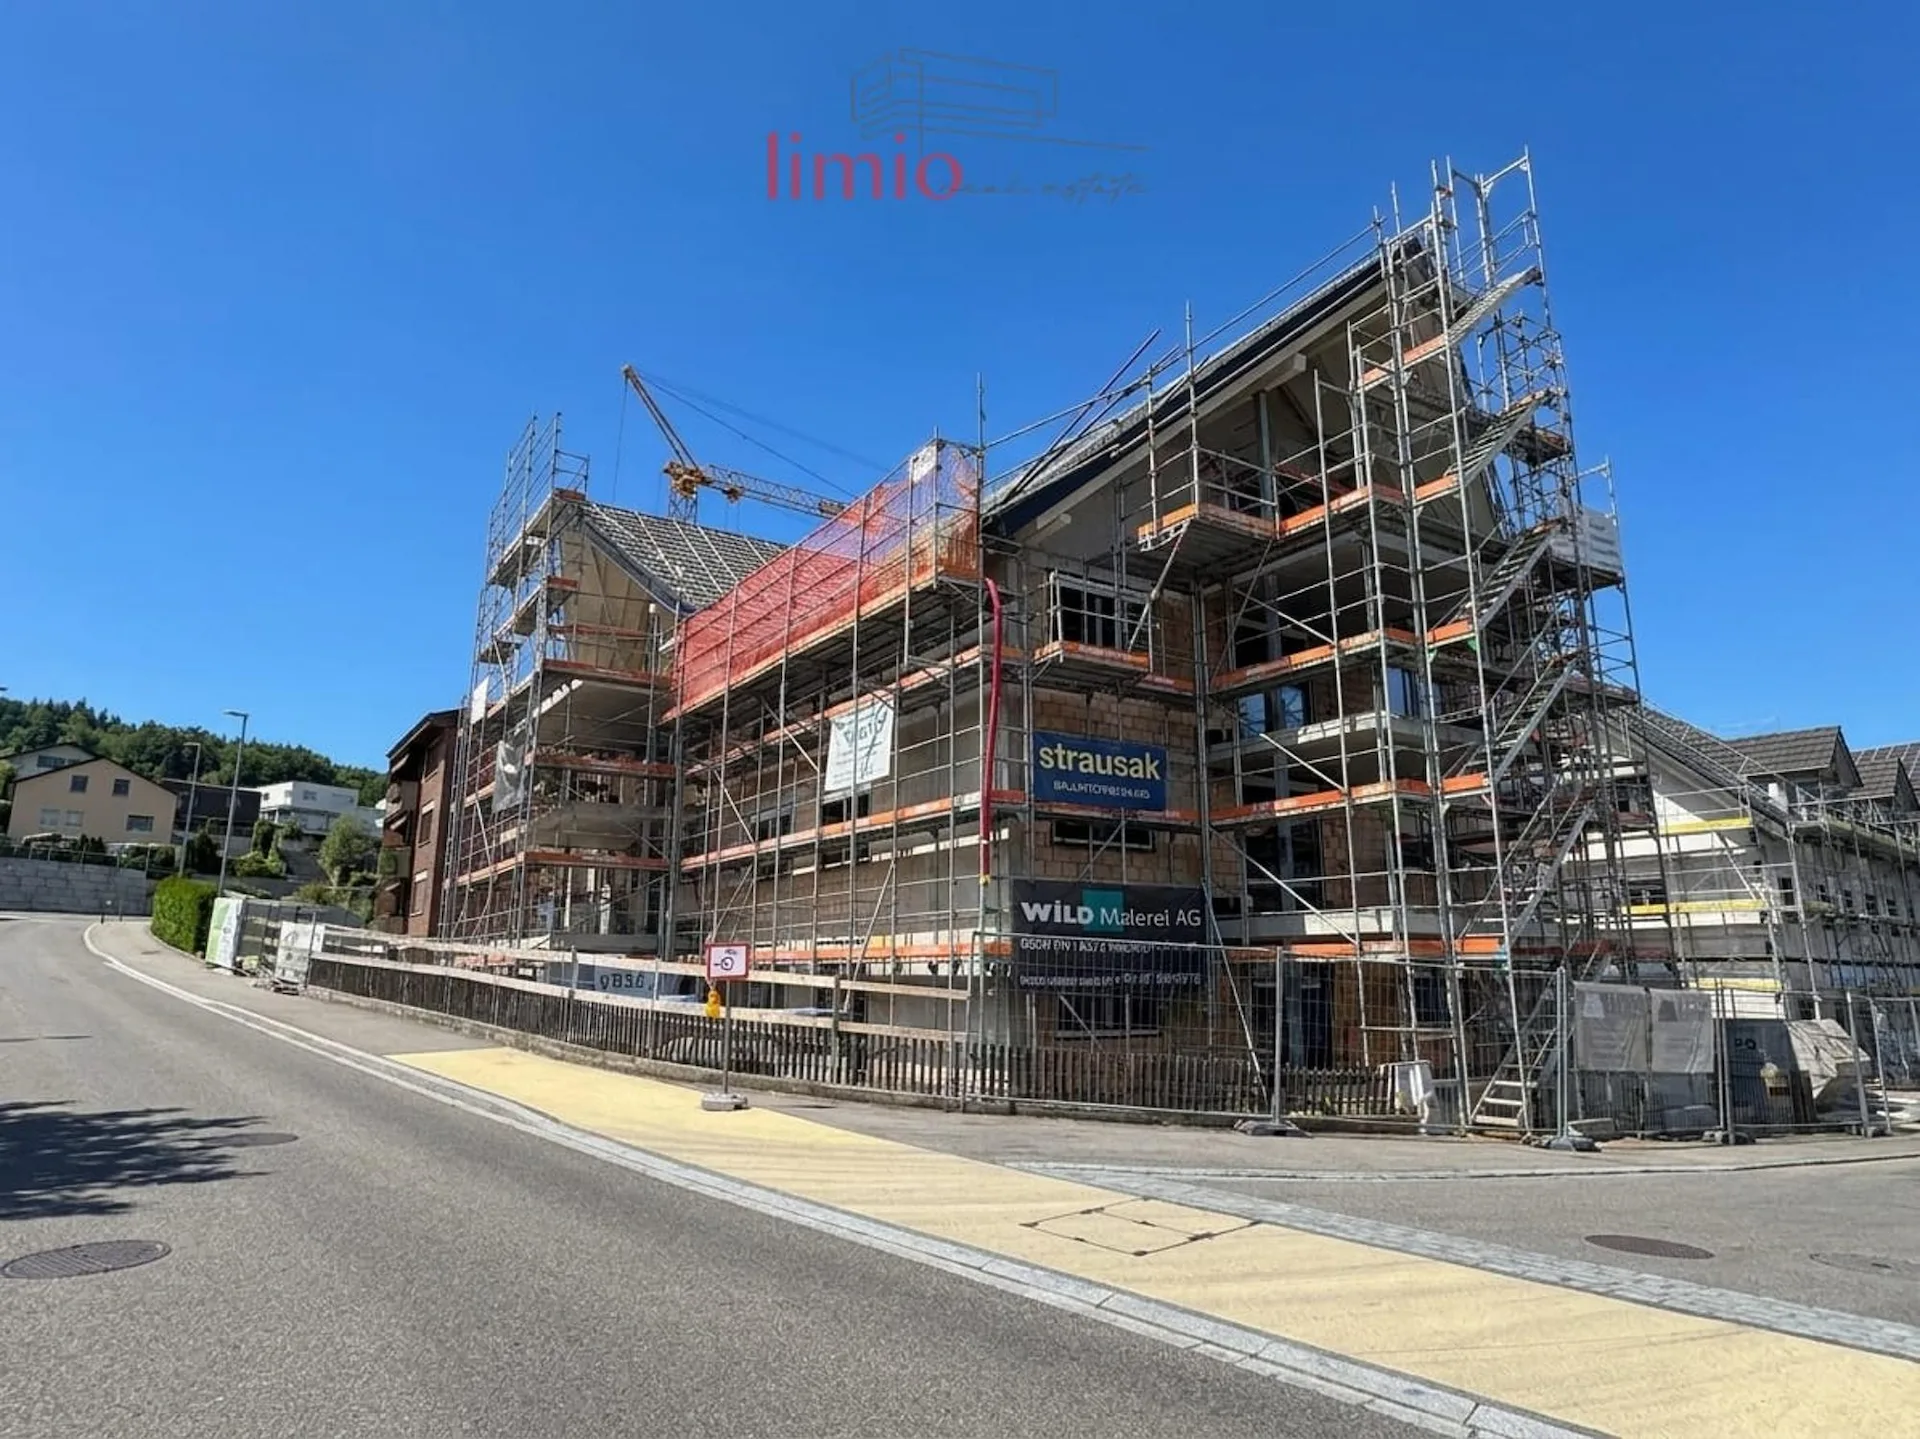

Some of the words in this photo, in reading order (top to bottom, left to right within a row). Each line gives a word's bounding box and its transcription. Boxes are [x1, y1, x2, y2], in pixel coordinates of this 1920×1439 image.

[1039, 743, 1161, 780] strausak
[1099, 906, 1170, 928] Malerei
[1174, 908, 1202, 928] AG
